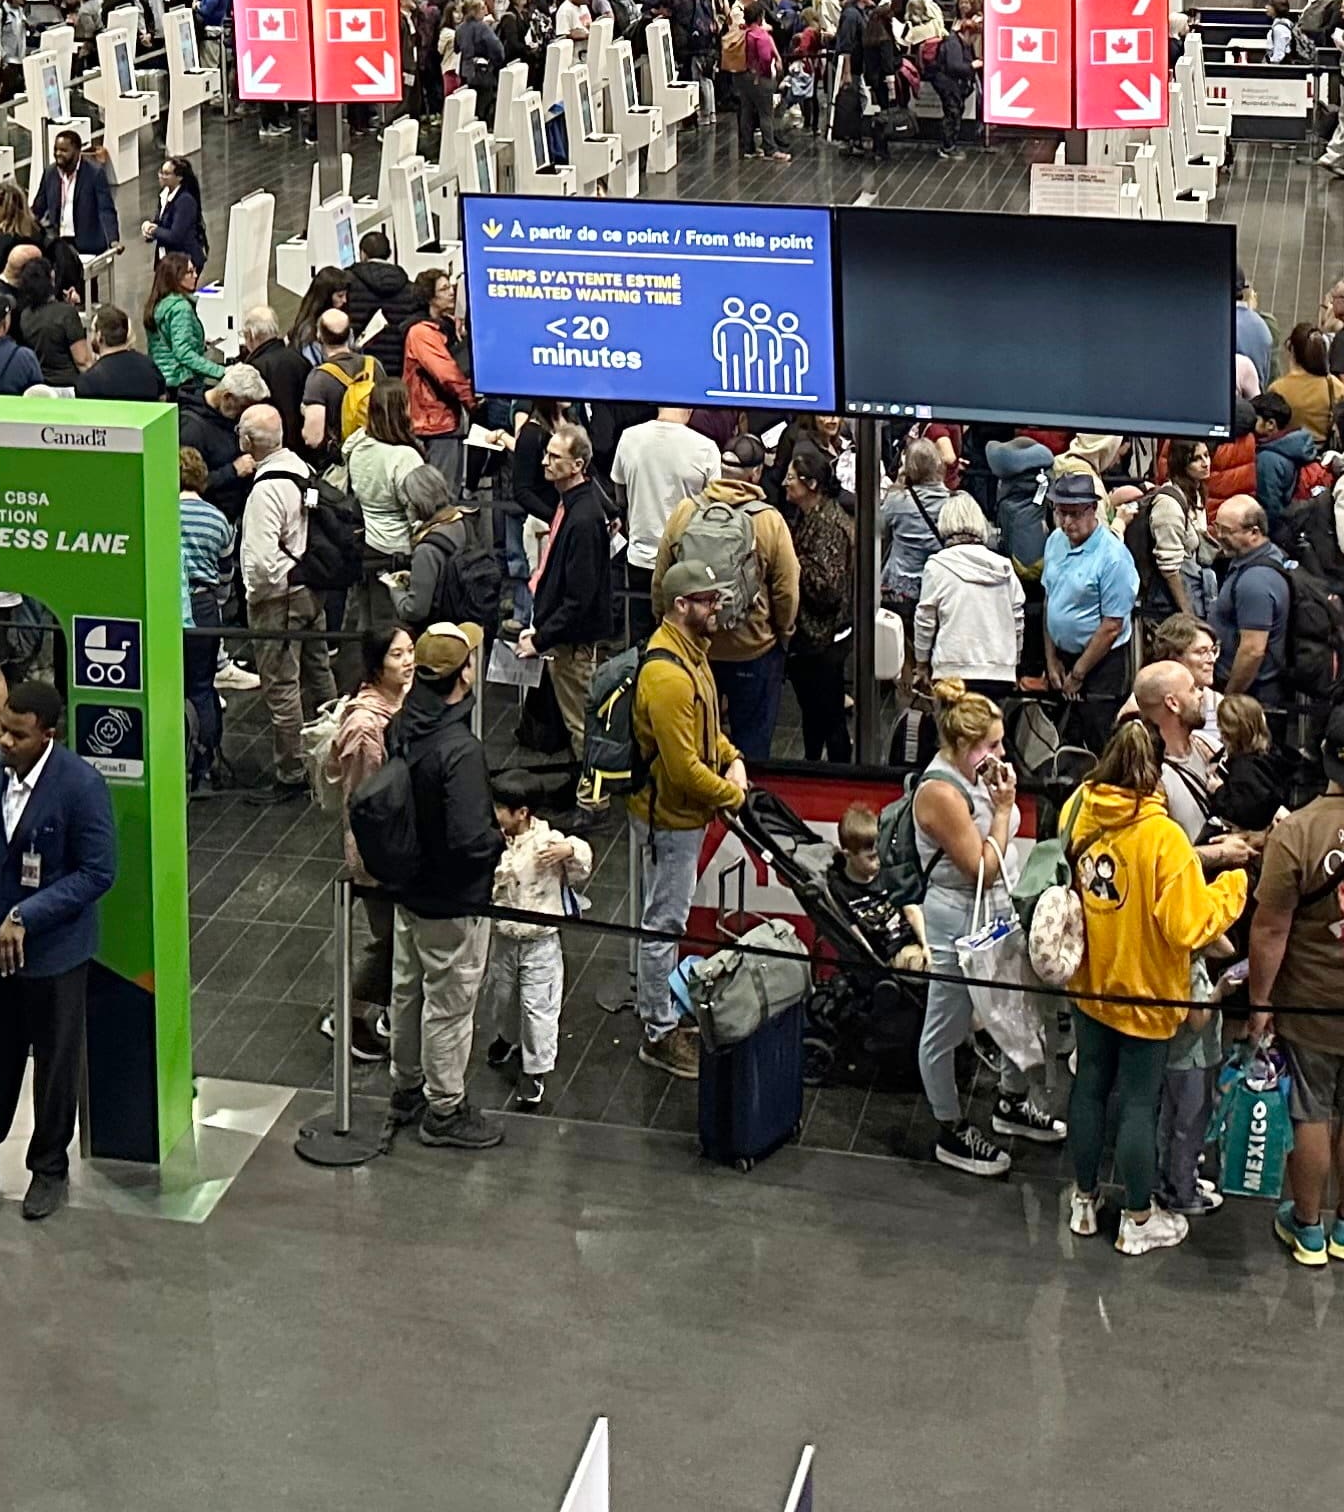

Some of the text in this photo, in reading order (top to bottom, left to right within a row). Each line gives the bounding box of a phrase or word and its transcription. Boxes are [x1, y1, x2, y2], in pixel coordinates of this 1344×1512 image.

[529, 225, 573, 242] partir
[577, 226, 598, 241] de
[602, 230, 622, 242] ce
[627, 228, 669, 246] point
[685, 230, 729, 247] From
[733, 232, 765, 248] this
[769, 234, 813, 252] point
[487, 268, 682, 290] TEMPS D'ATTENTE ESTIMÉ
[488, 284, 682, 305] ESTIMATED WAITING TIME
[532, 342, 642, 369] minutes
[41, 426, 106, 447] Canada
[5, 490, 50, 506] CBSA
[56, 531, 129, 555] LANE
[1243, 1100, 1267, 1192] MEXICO
